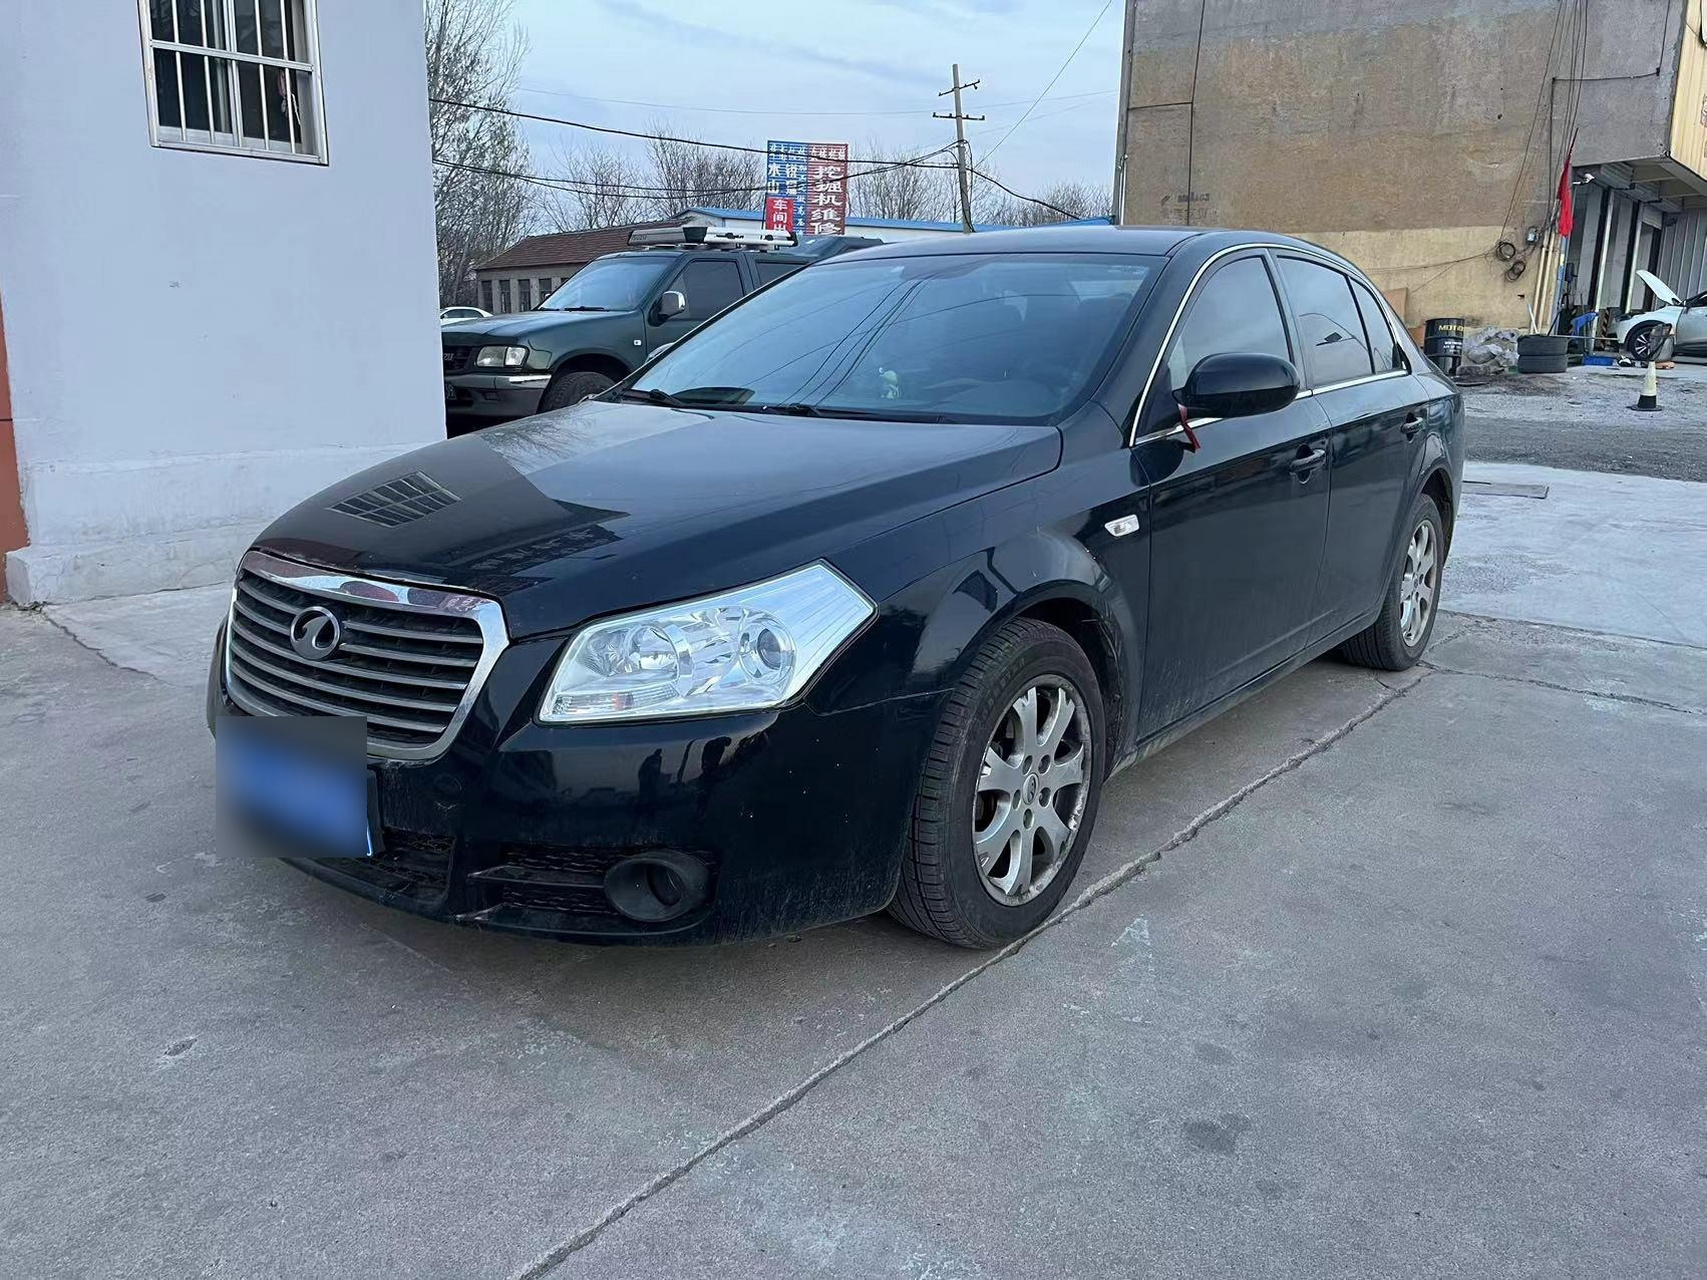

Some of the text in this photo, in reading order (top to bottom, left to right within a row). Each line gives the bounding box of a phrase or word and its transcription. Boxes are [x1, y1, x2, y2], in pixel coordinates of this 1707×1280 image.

[810, 165, 844, 235] 挖掘机维修
